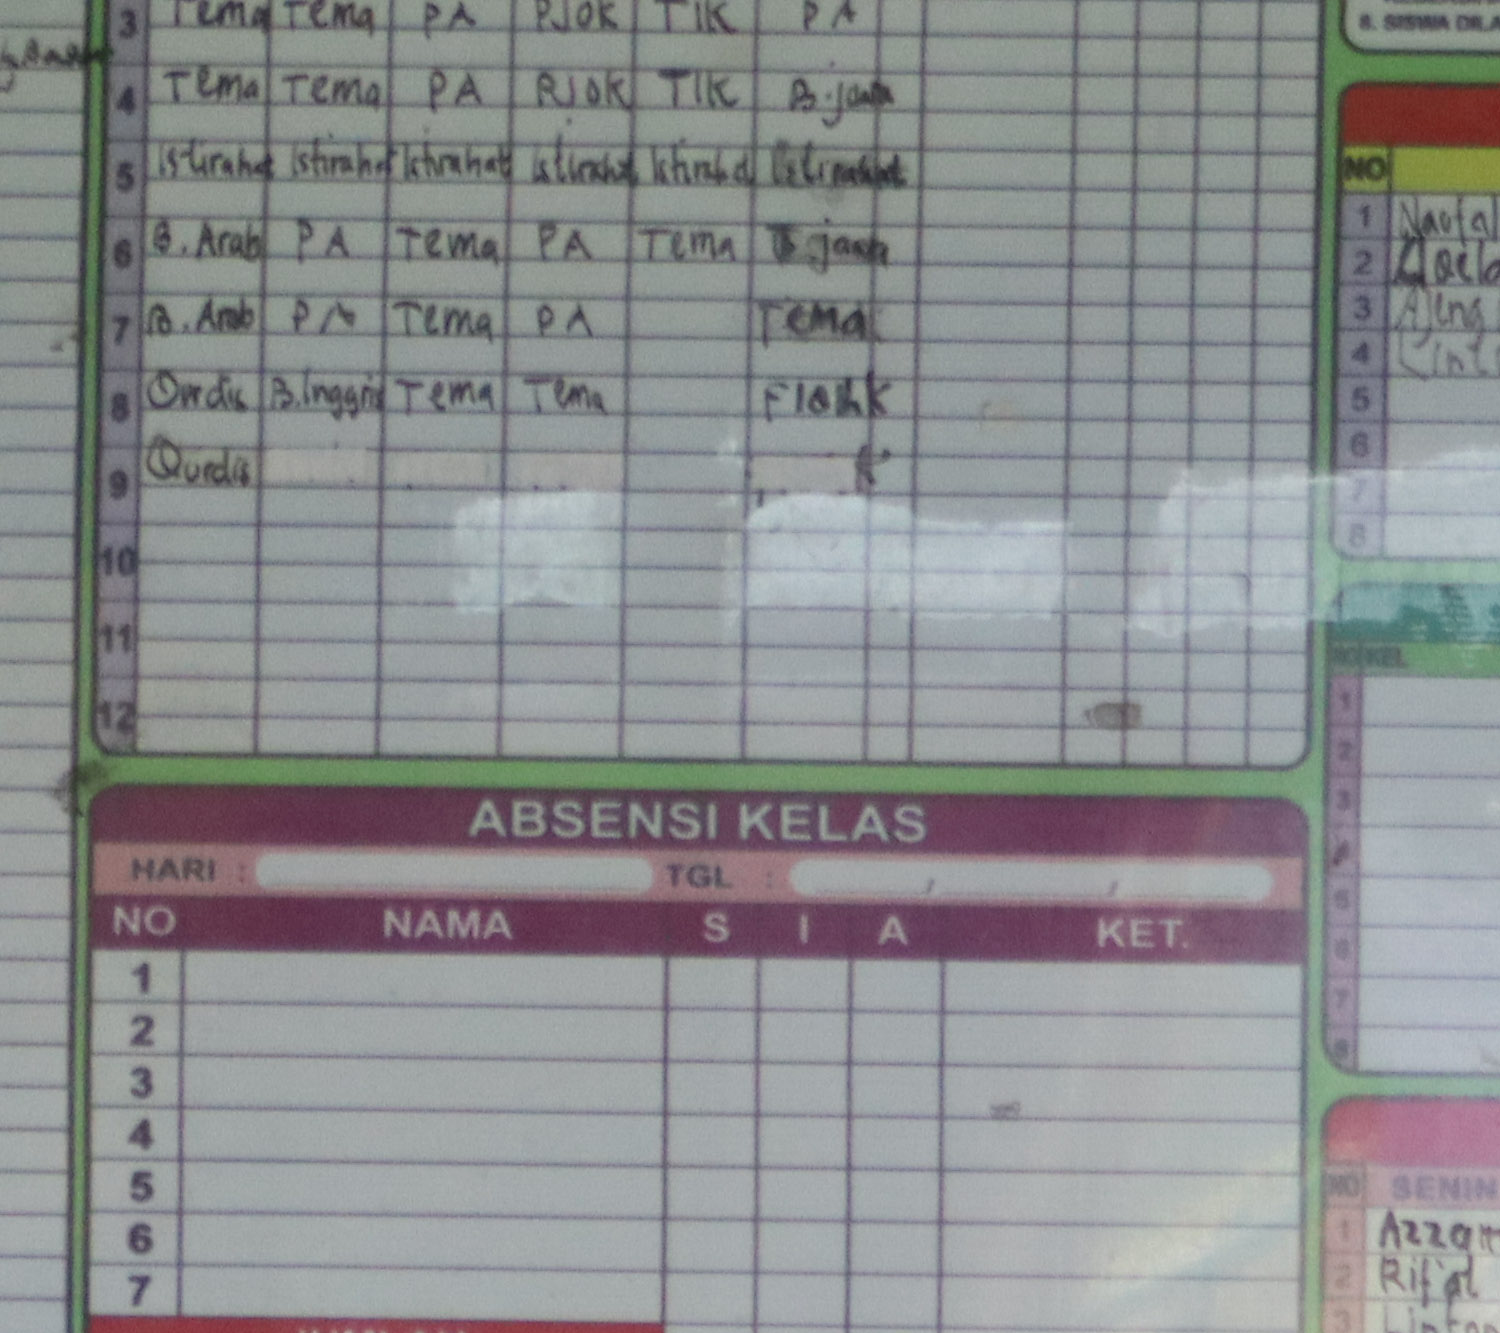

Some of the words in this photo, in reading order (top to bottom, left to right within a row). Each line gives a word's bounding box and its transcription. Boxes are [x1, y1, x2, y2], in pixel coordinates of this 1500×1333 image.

[117, 8, 137, 39] 3
[116, 85, 136, 116] 4
[282, 74, 381, 112] Tema
[657, 68, 739, 109] TIK
[116, 161, 135, 192] 5
[1345, 157, 1386, 182] NO
[1357, 205, 1371, 227] 1
[113, 238, 133, 269] 6
[396, 226, 499, 266] Tema
[1354, 256, 1373, 279] 2
[392, 301, 494, 345] Tema
[1353, 298, 1372, 321] 3
[112, 315, 131, 346] 7
[1350, 342, 1371, 366] 4
[111, 391, 131, 423] 8
[1351, 387, 1371, 411] 5
[1350, 432, 1370, 458] 6
[109, 469, 128, 498] 9
[102, 546, 137, 577] 10
[99, 623, 131, 653] 11
[97, 702, 136, 735] 12
[468, 798, 717, 840] ABSENSI
[737, 803, 928, 844] KELAS
[131, 856, 216, 883] HARI
[665, 864, 731, 890] TGL
[112, 906, 177, 936] NO
[383, 909, 514, 941] NAMA
[703, 913, 731, 943] S
[877, 915, 909, 946] A
[1096, 919, 1189, 949] KET.
[131, 962, 151, 995] 1
[128, 1015, 156, 1047] 2
[128, 1067, 154, 1099] 3
[126, 1119, 155, 1151] 4
[128, 1171, 154, 1203] 5
[1390, 1175, 1498, 1201] SENIN
[127, 1223, 153, 1255] 6
[127, 1275, 151, 1307] 7
